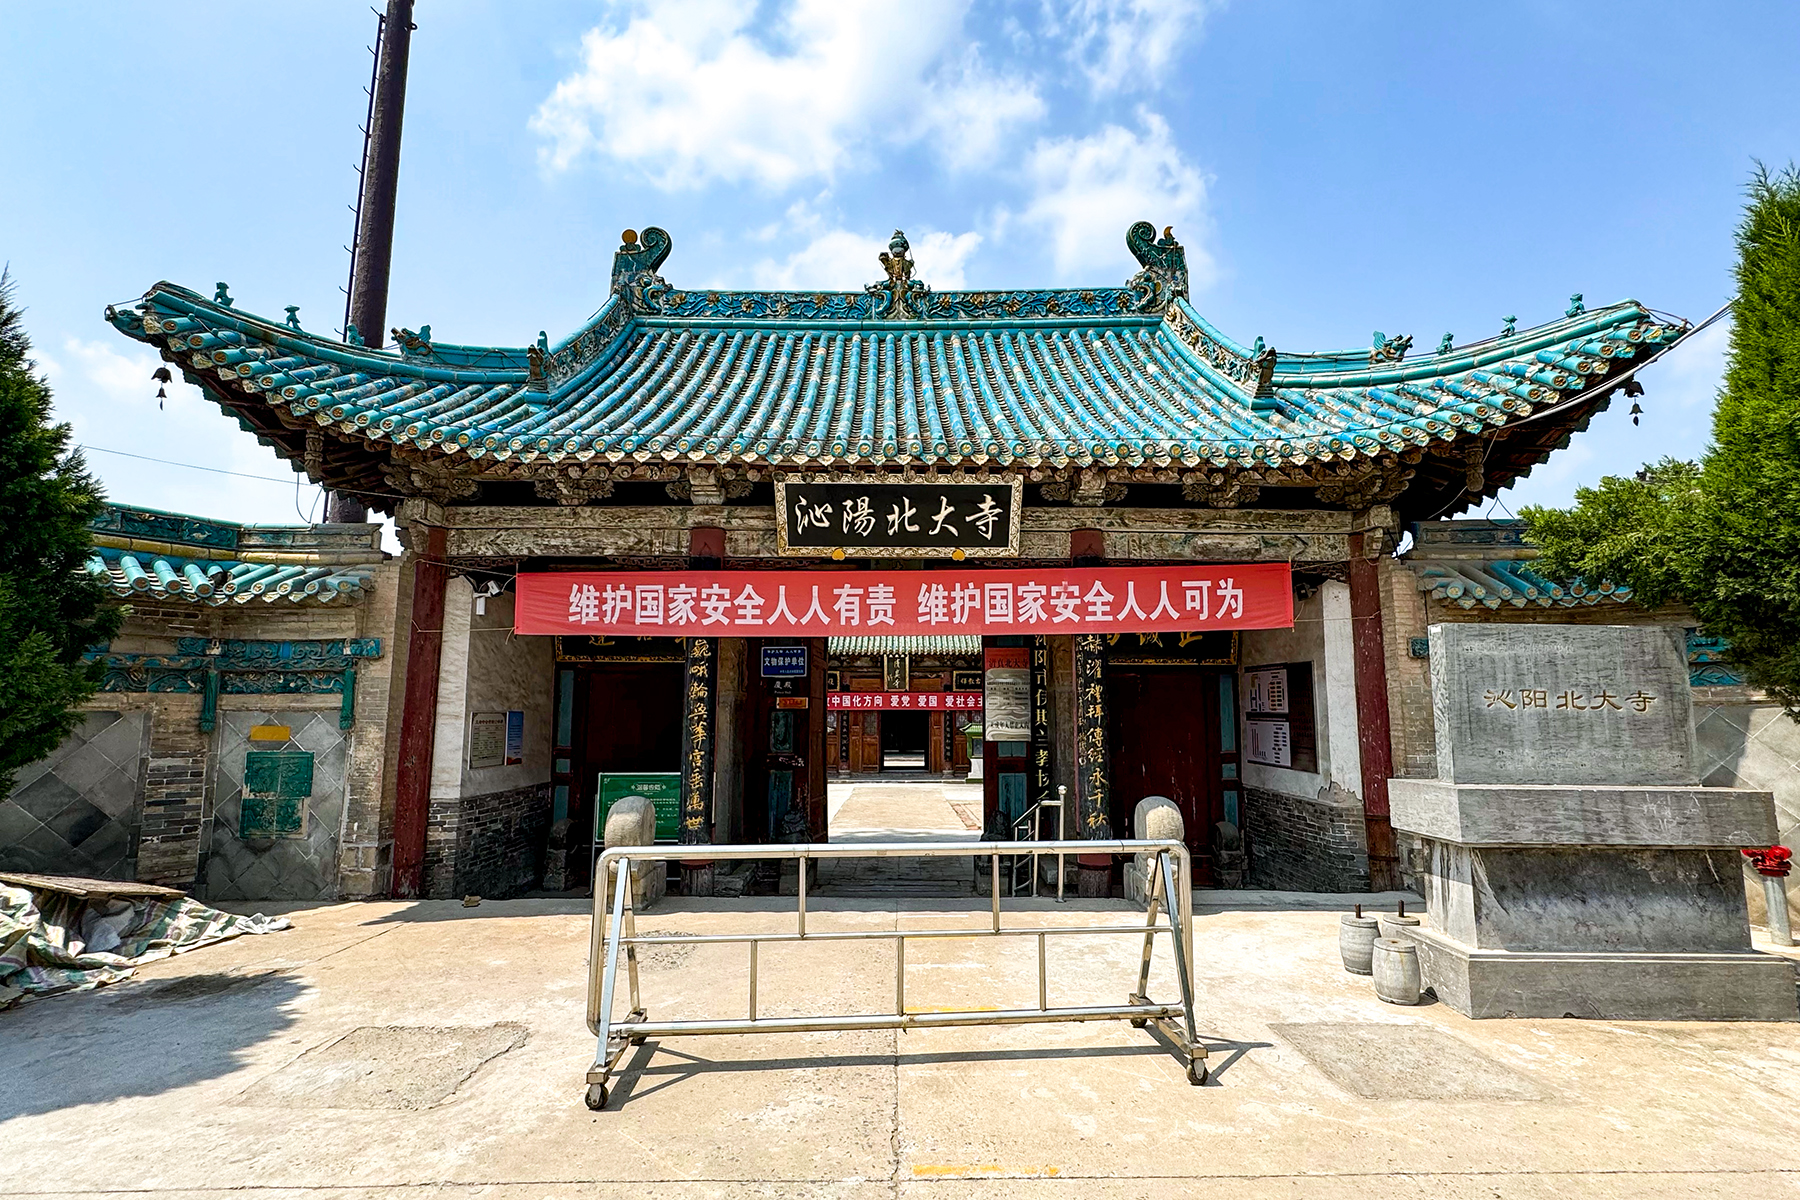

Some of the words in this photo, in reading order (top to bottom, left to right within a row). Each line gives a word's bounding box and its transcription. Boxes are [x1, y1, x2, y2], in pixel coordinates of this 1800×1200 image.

[795, 495, 1003, 541] 沁陽北大寺
[568, 583, 896, 626] 维护国家安全人人有责
[917, 578, 1244, 625] 维护国家安全人人可为
[764, 656, 804, 667] 文物保护单位
[890, 695, 911, 708] 爱党
[918, 695, 938, 708] 爱国
[1483, 688, 1658, 712] 沁阳北大寺
